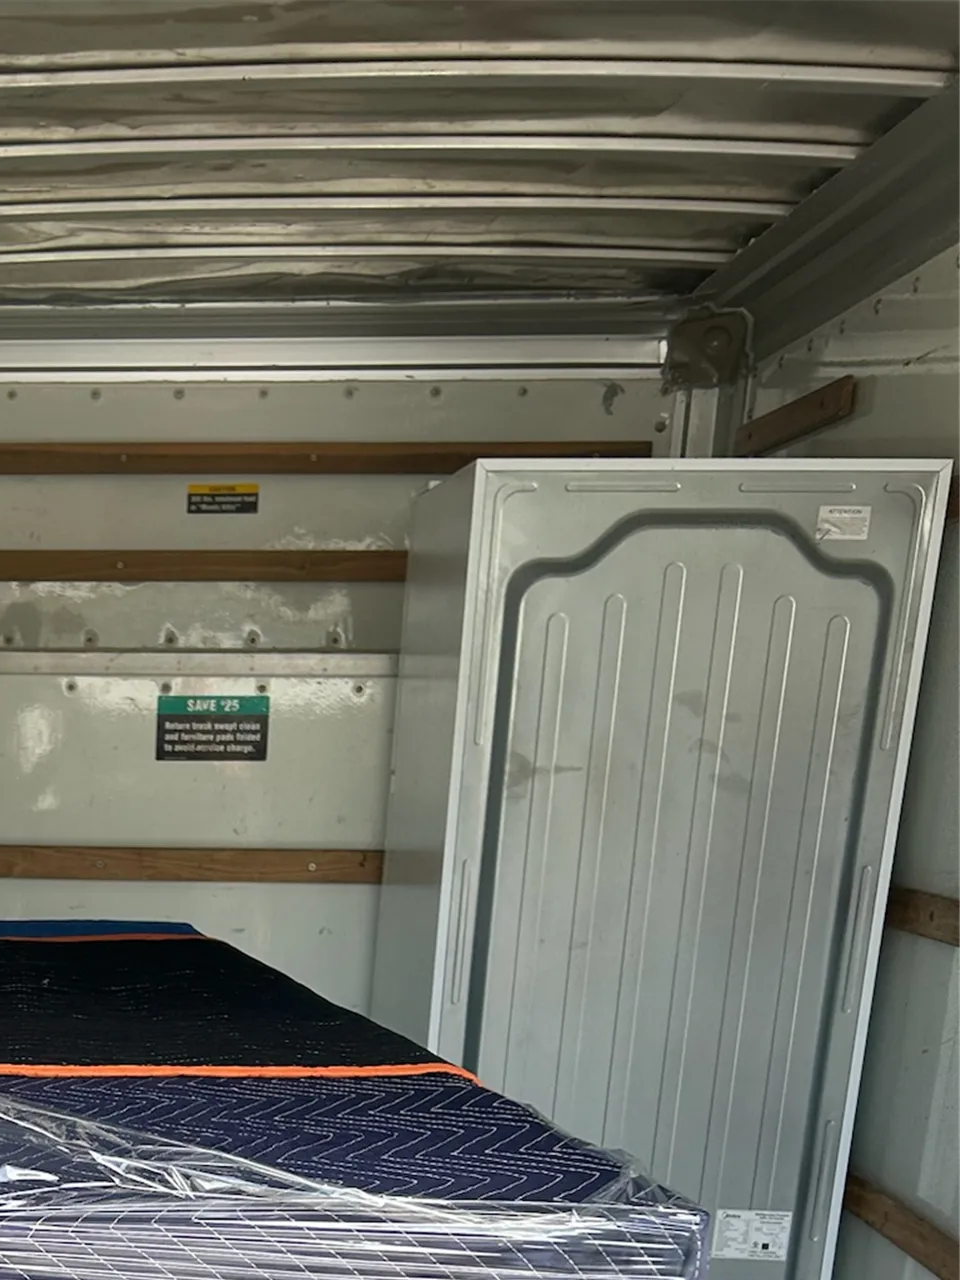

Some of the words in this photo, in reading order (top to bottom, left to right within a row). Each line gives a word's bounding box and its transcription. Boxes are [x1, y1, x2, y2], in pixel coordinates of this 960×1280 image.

[187, 699, 217, 712] SAVE
[164, 721, 190, 730] Return
[164, 733, 179, 741] and
